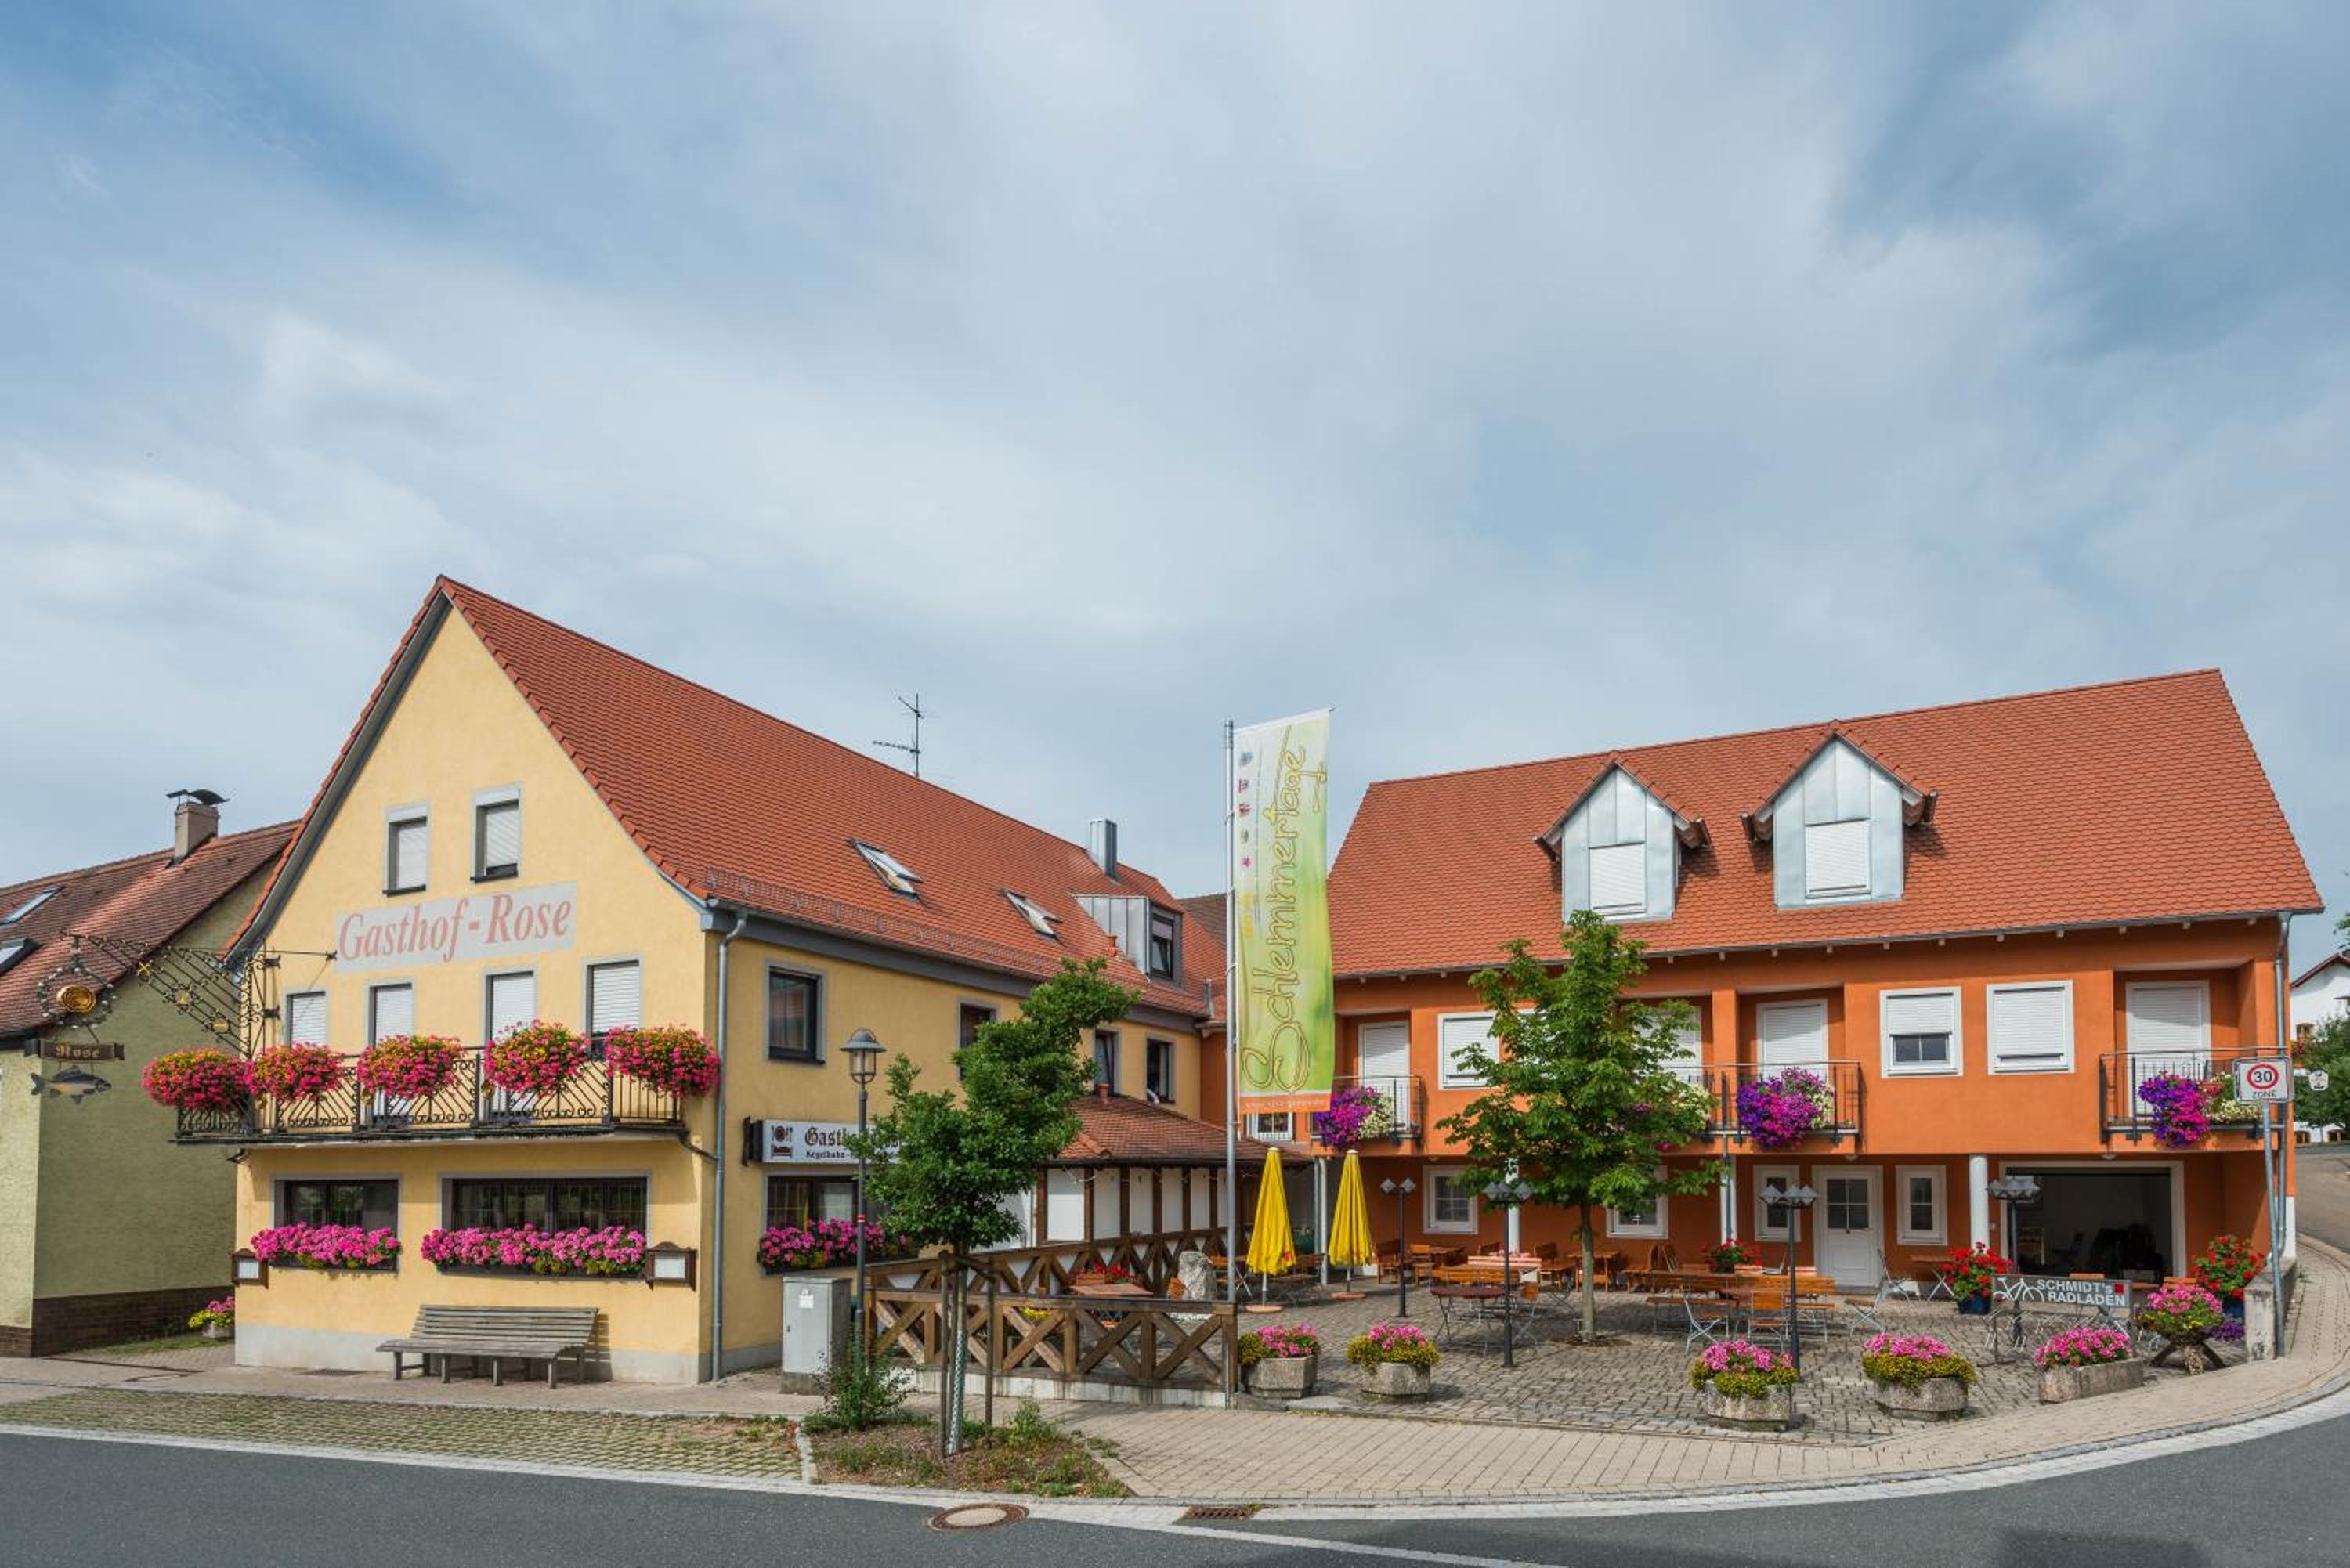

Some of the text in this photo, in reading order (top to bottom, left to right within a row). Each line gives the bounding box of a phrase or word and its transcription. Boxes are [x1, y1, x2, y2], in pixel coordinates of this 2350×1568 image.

[1240, 741, 1327, 1092] Schlemmertage
[55, 1042, 101, 1059] Rose
[2254, 1071, 2272, 1083] 30
[2037, 1279, 2113, 1295] SCHMIDT's
[2047, 1291, 2126, 1306] RADLADEN
